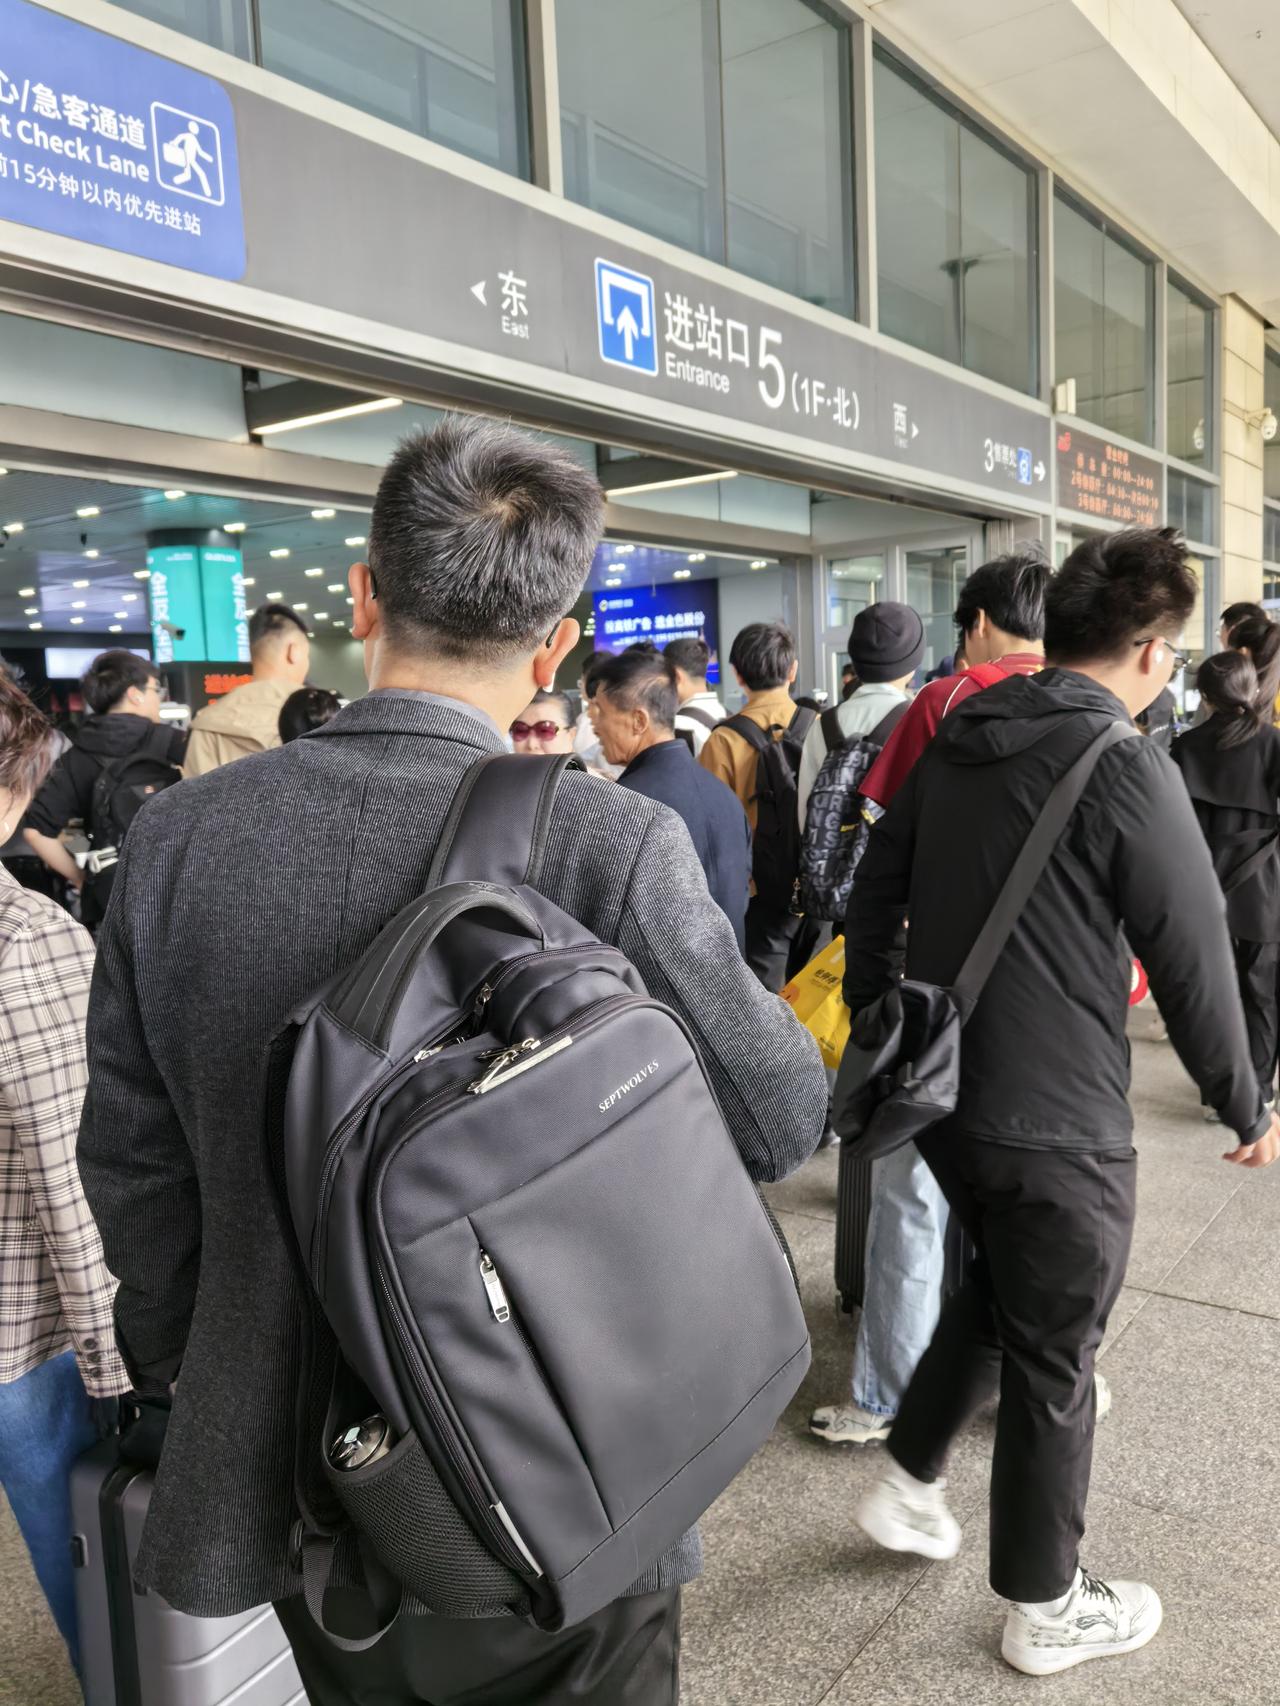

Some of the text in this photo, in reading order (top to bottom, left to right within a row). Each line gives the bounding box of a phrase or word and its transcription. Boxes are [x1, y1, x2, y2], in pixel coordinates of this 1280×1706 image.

[16, 119, 92, 164] Check
[96, 144, 150, 183] Lane
[497, 270, 528, 316] 东
[502, 315, 530, 340] East
[664, 291, 750, 368] 进站口
[758, 326, 786, 410] 5
[665, 352, 731, 394] Entrance
[893, 402, 907, 434] 西
[598, 1058, 659, 1113] SEPTWOLVES
